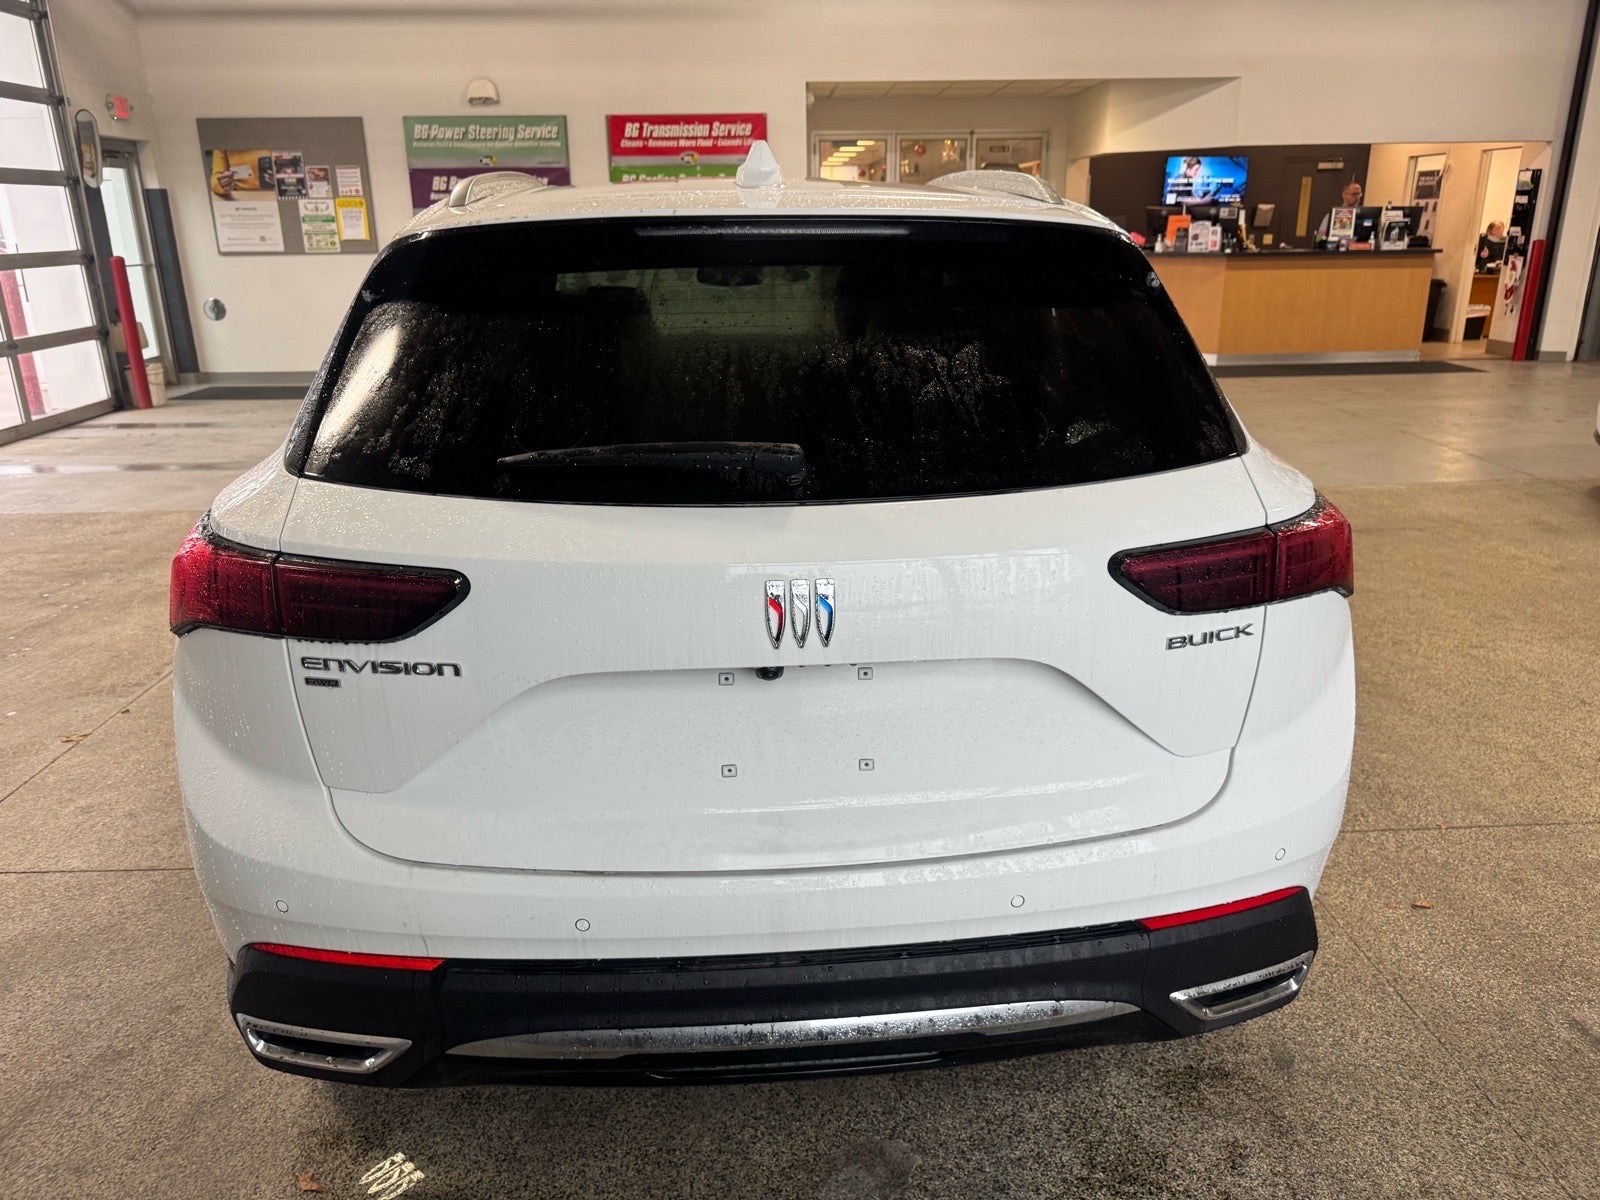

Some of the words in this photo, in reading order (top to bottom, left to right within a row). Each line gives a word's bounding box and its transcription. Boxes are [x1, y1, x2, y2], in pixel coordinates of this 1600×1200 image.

[414, 124, 428, 140] BG
[431, 124, 466, 140] Power
[468, 123, 515, 142] Steering
[517, 123, 559, 139] Service
[625, 122, 639, 138] BG
[642, 121, 709, 138] Transmission
[711, 121, 753, 137] Service
[432, 176, 448, 191] BG
[1165, 623, 1254, 651] BUICK
[301, 656, 463, 677] ENVISION
